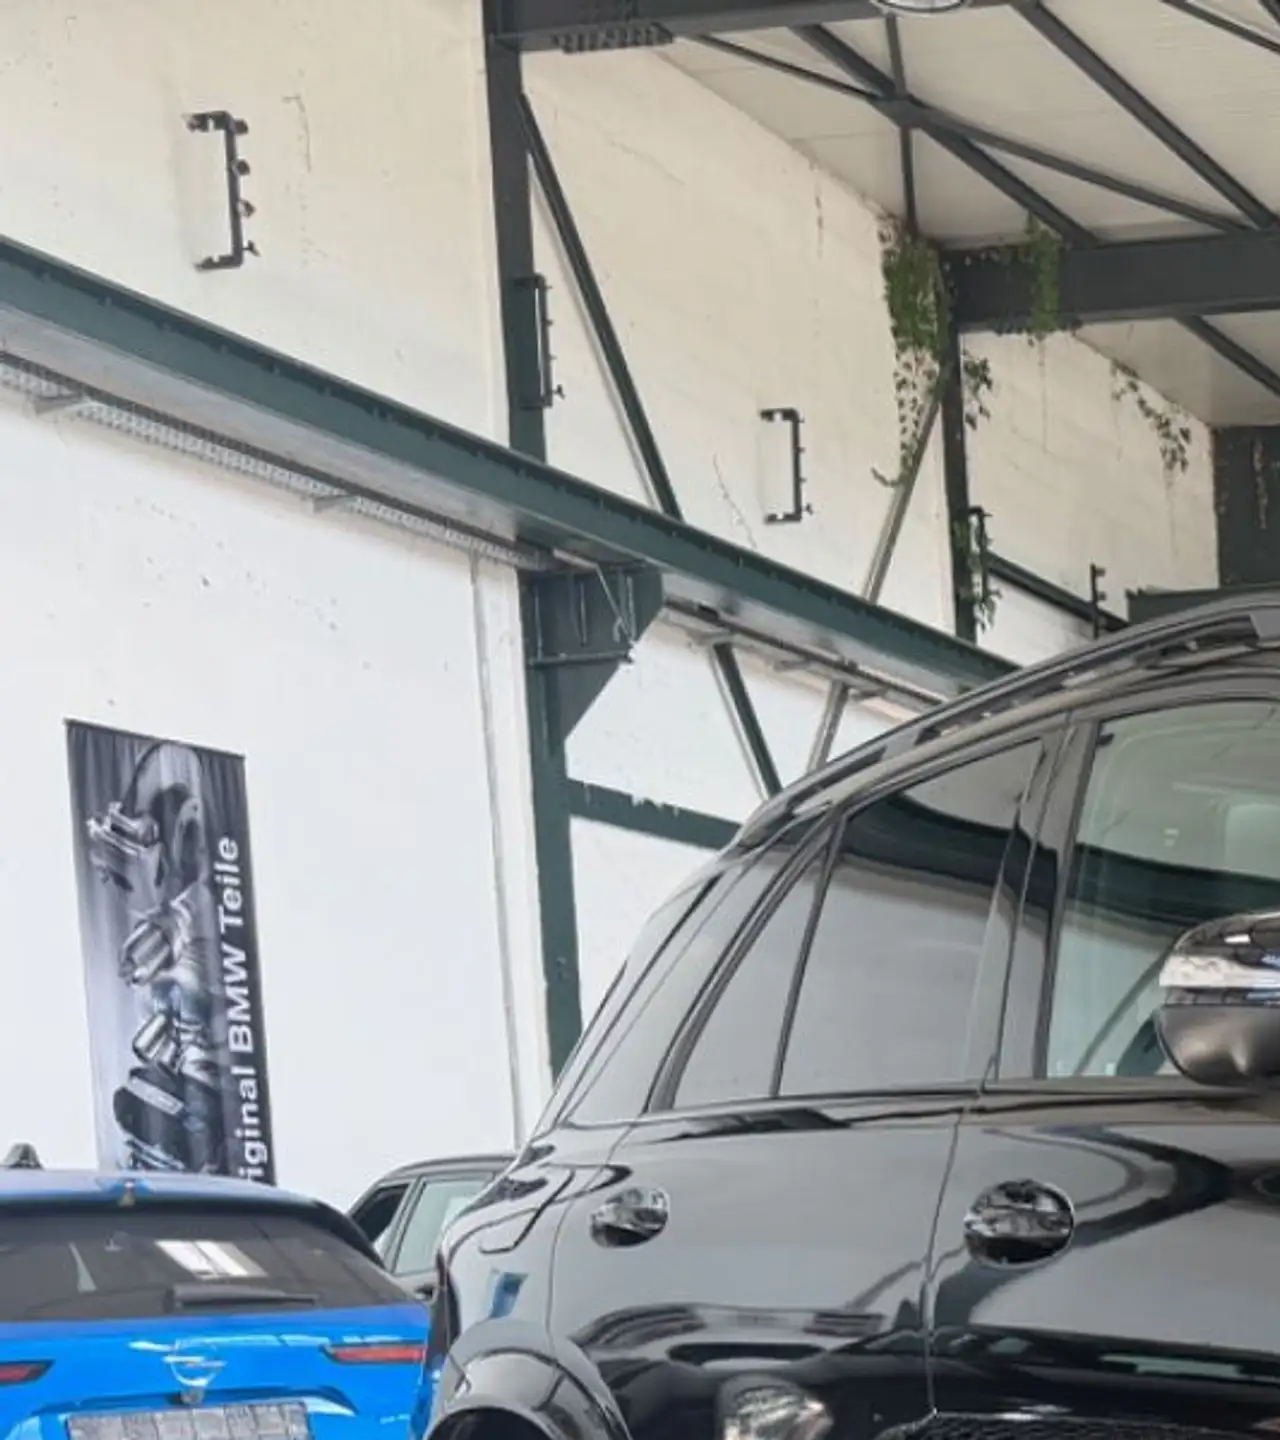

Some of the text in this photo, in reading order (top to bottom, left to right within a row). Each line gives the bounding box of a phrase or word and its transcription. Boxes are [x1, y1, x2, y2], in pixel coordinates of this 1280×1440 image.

[213, 837, 268, 1181] iginal BMW Teile
